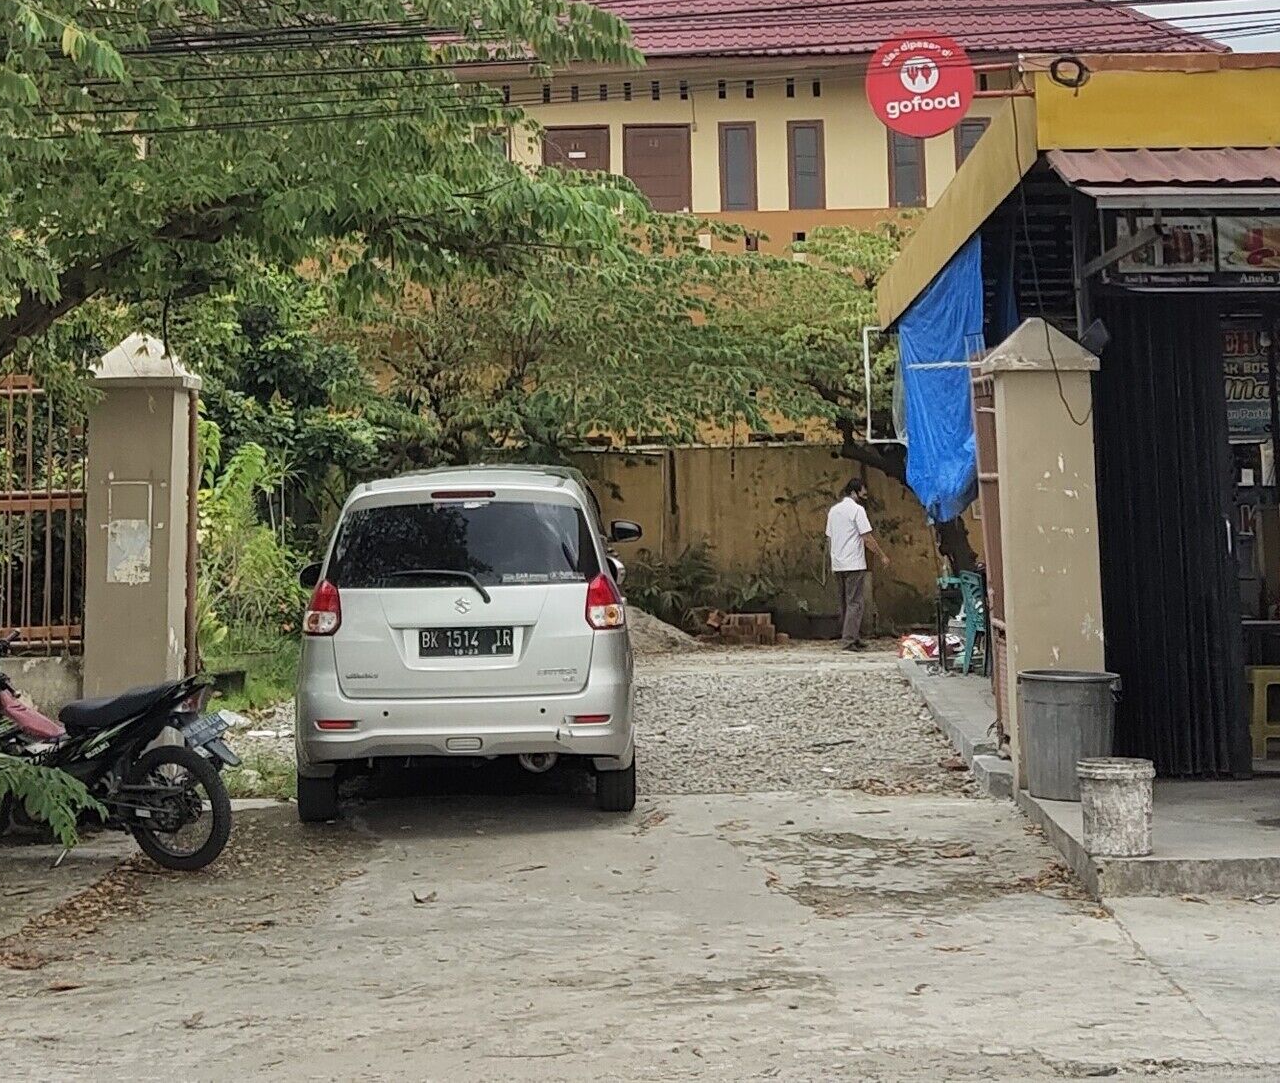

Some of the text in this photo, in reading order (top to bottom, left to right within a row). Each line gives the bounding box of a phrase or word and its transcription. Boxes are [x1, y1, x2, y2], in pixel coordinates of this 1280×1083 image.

[886, 92, 960, 118] gofood
[1240, 272, 1275, 284] Aneka
[1222, 330, 1258, 356] EH
[1244, 361, 1269, 374] BOS
[422, 631, 438, 647] BK
[446, 630, 479, 647] 1514
